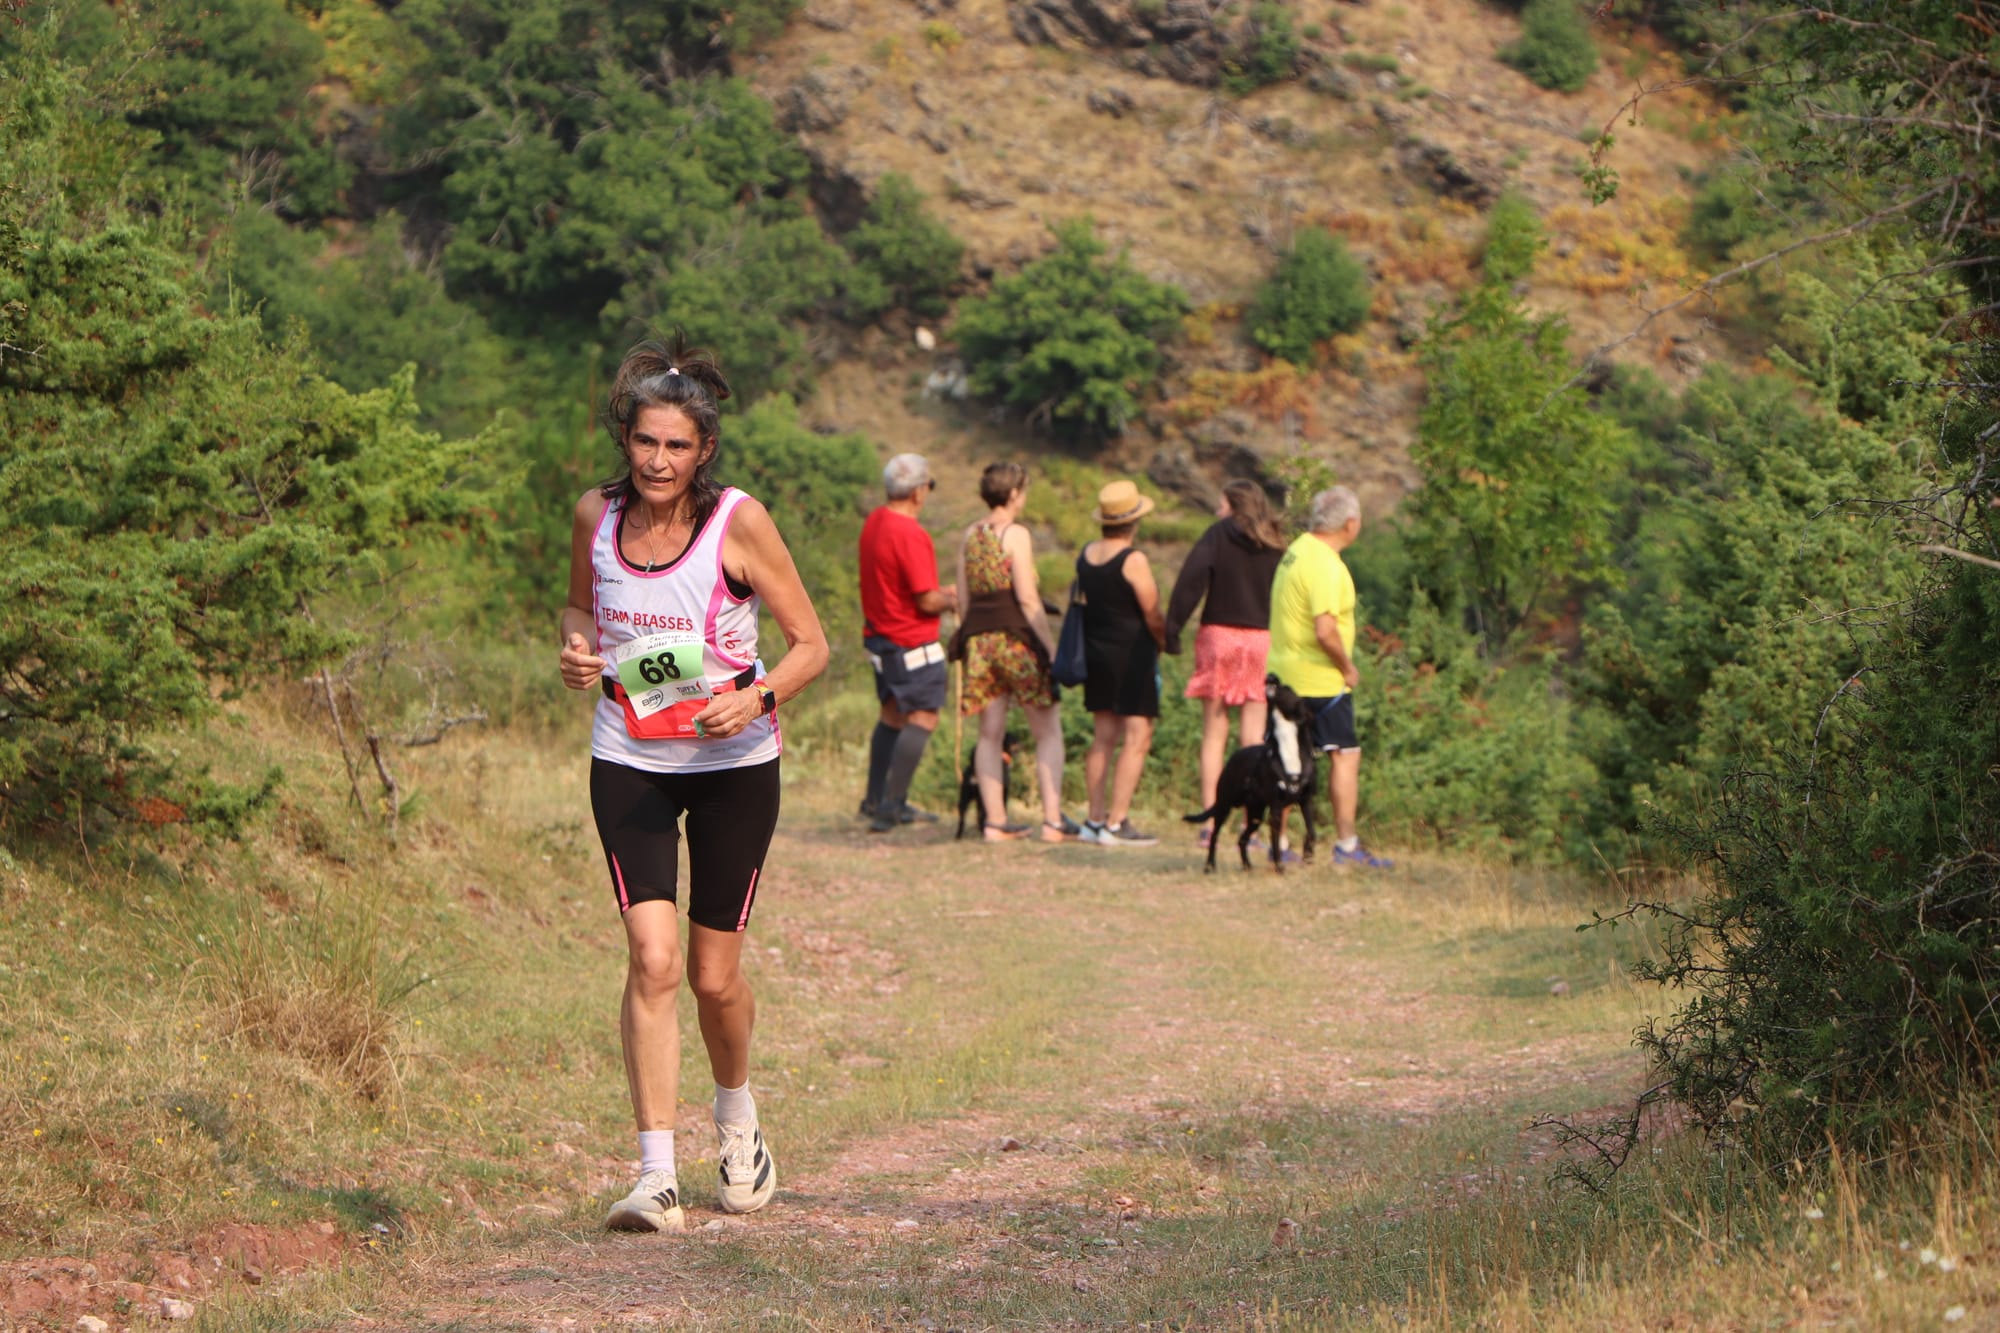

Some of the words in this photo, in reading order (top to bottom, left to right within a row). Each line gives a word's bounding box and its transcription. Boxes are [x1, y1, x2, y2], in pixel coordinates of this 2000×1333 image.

[602, 607, 629, 624] TEAM
[633, 612, 694, 632] BIASSES
[638, 652, 681, 685] 68
